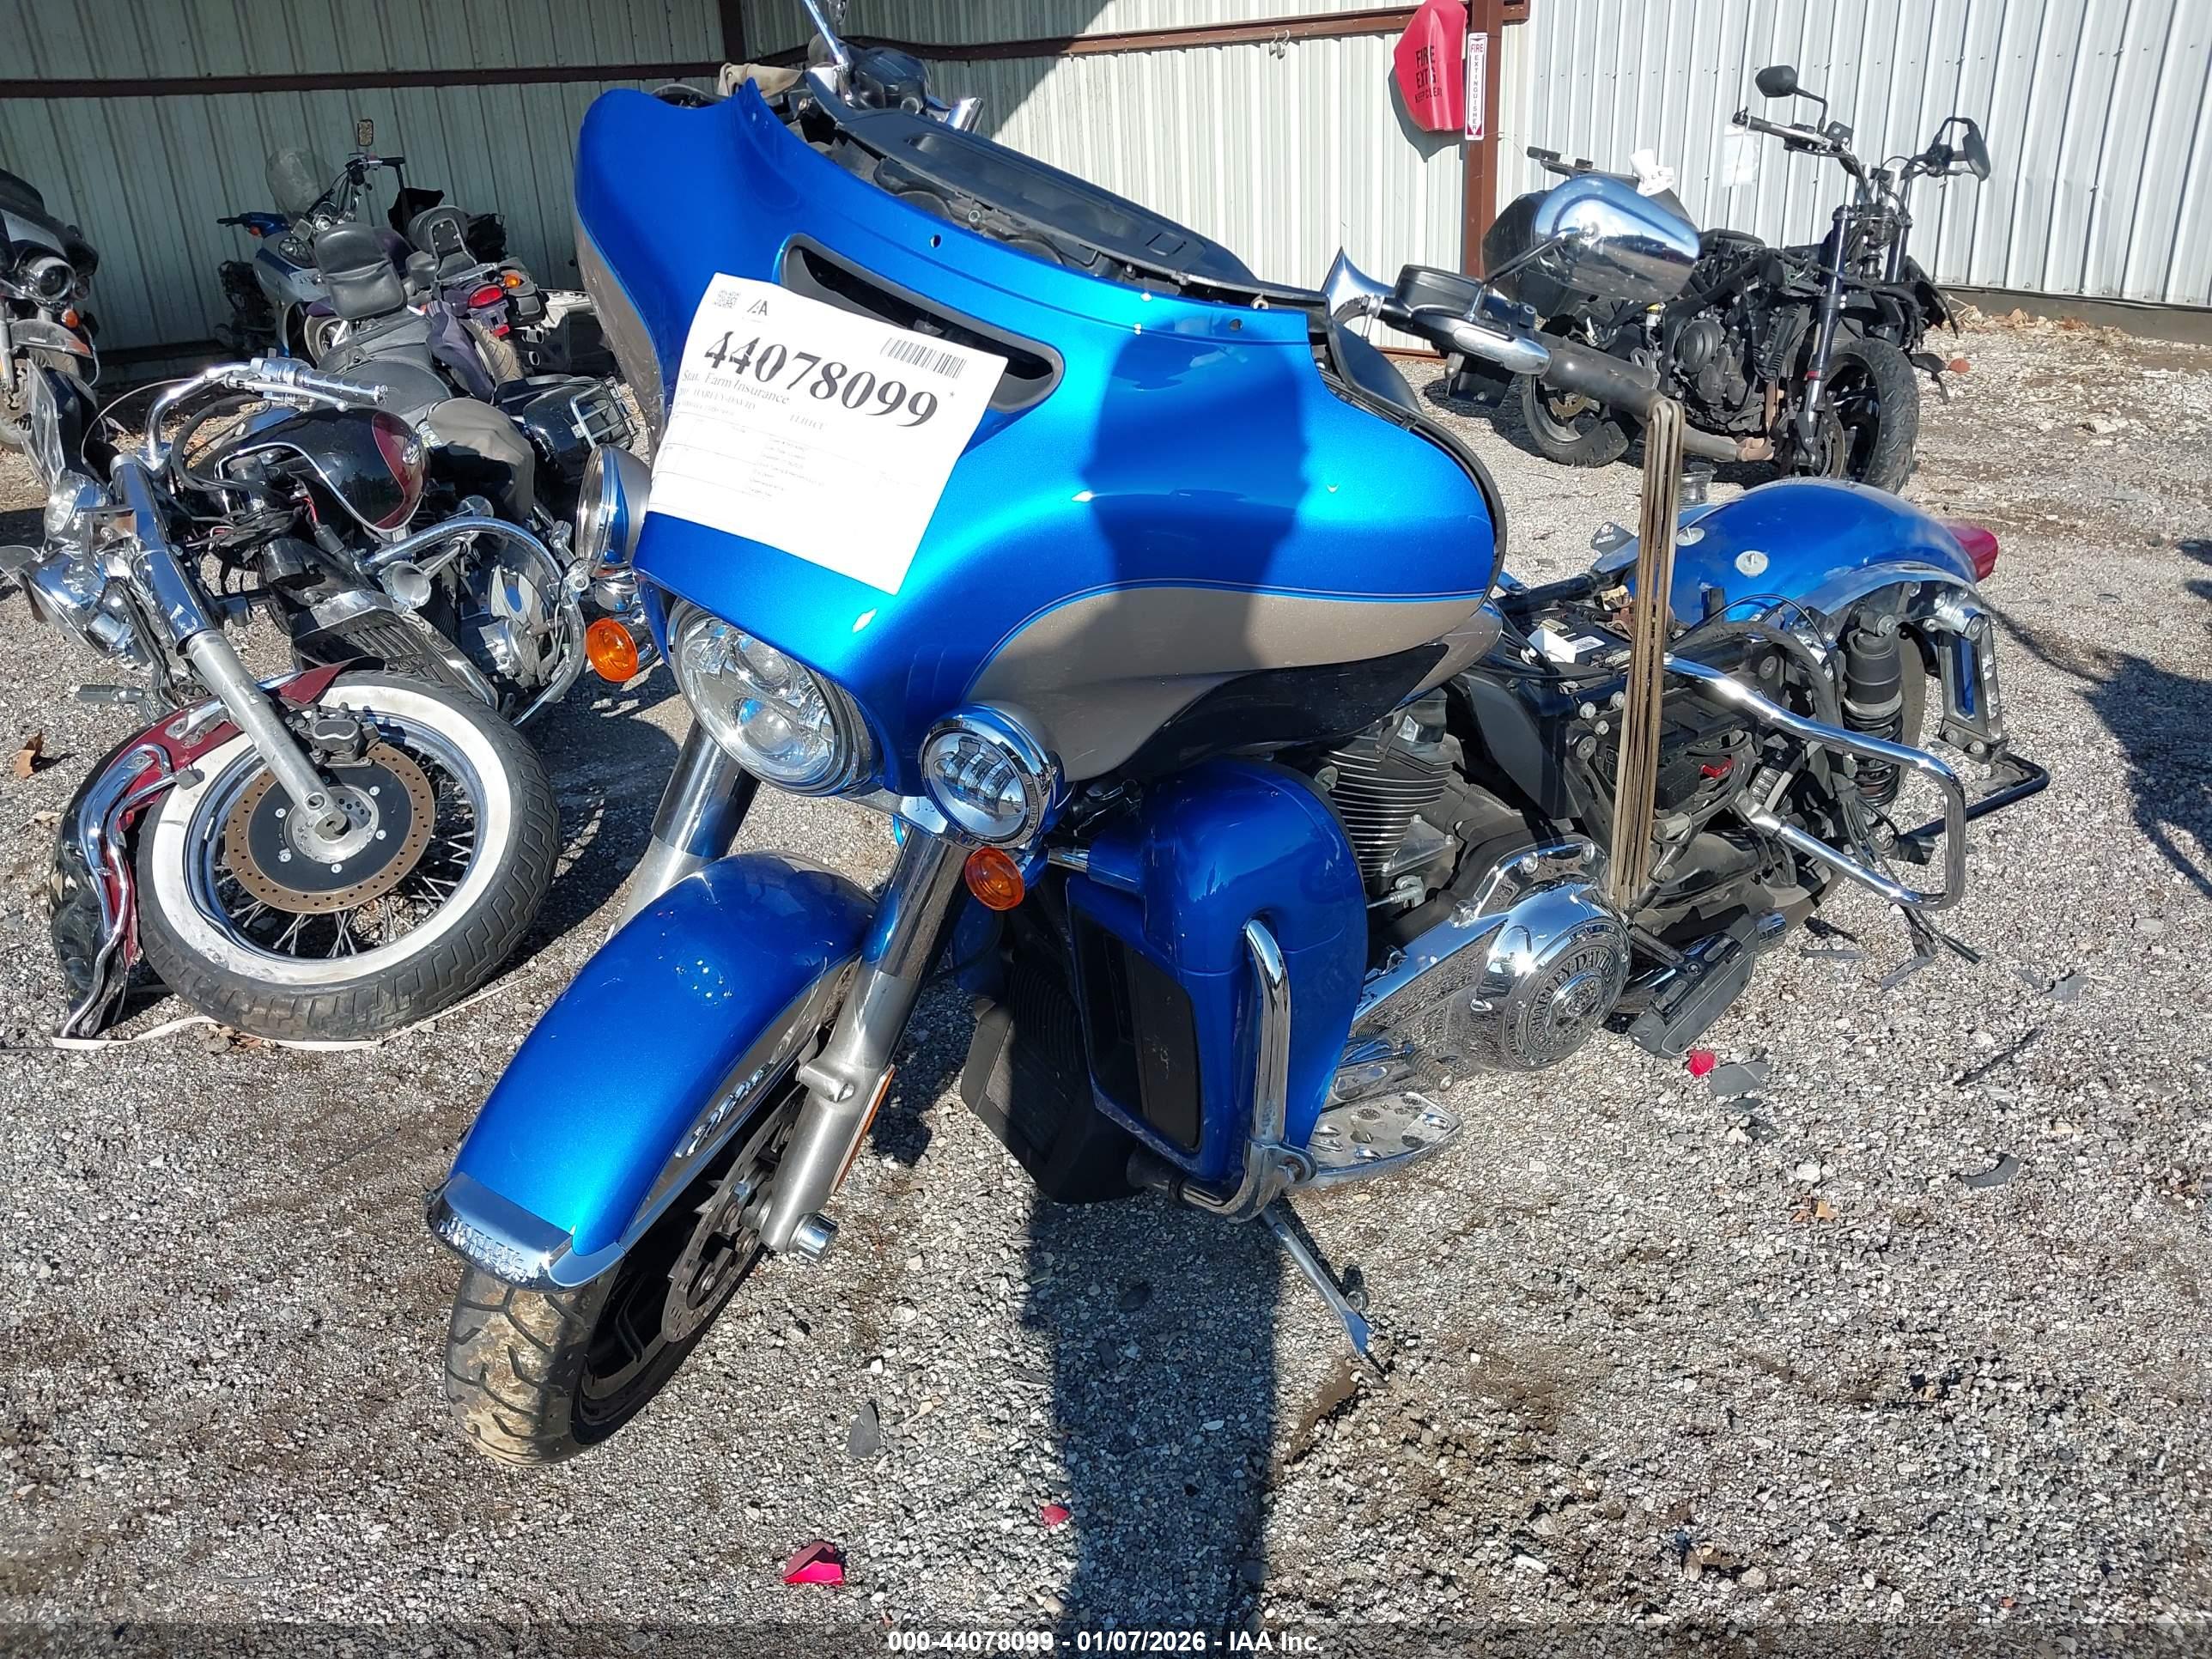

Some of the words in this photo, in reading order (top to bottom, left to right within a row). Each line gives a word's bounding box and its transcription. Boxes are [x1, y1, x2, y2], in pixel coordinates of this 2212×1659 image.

[1416, 46, 1436, 69] FIRE
[1471, 44, 1483, 52] FIRE
[704, 331, 939, 428] 44078099
[704, 372, 733, 389] Farm
[733, 378, 791, 405] Insurance
